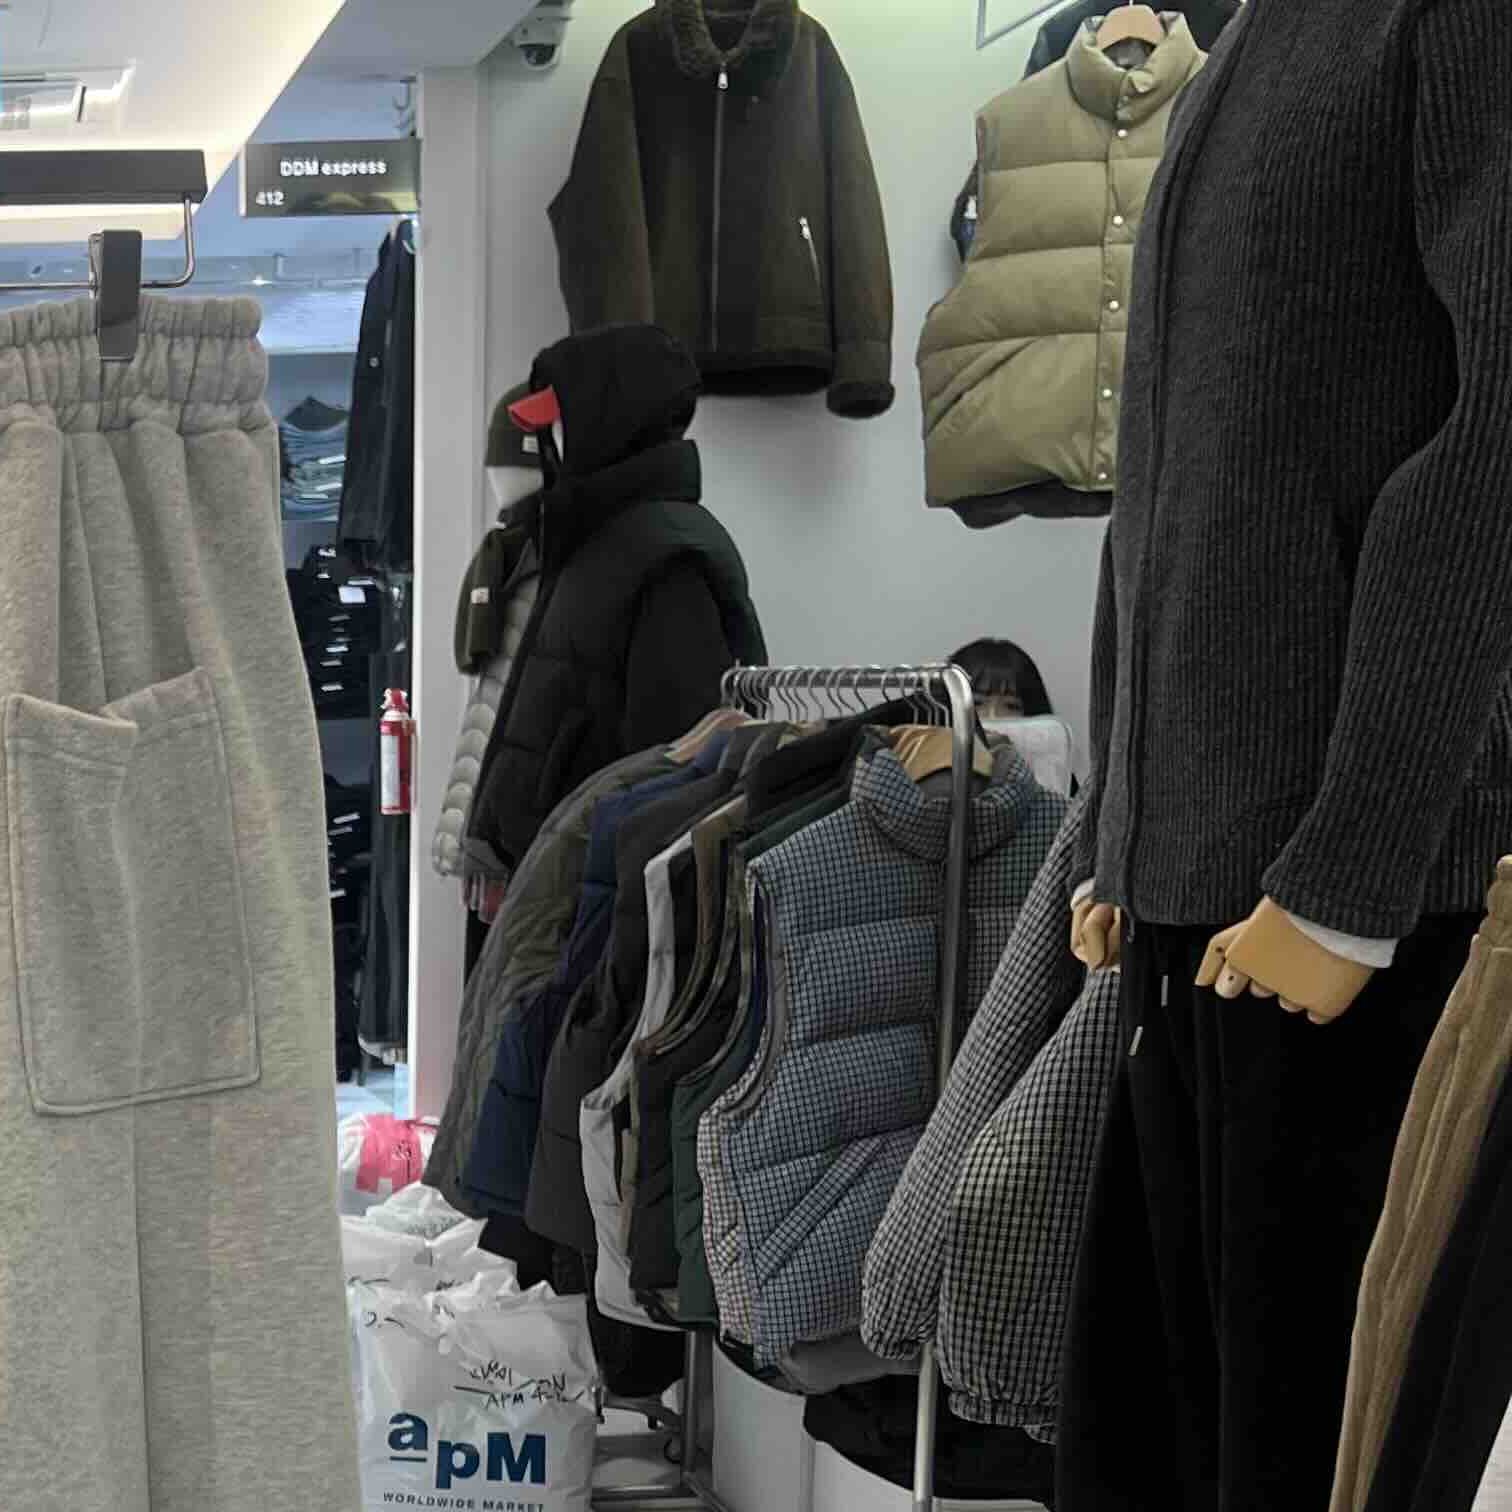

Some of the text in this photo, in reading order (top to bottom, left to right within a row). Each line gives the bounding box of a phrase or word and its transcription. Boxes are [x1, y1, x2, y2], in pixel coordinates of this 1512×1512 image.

[280, 160, 387, 177] DDM express
[255, 191, 285, 206] 412
[388, 1412, 547, 1490] apM
[383, 1492, 475, 1510] WORLDWIDE
